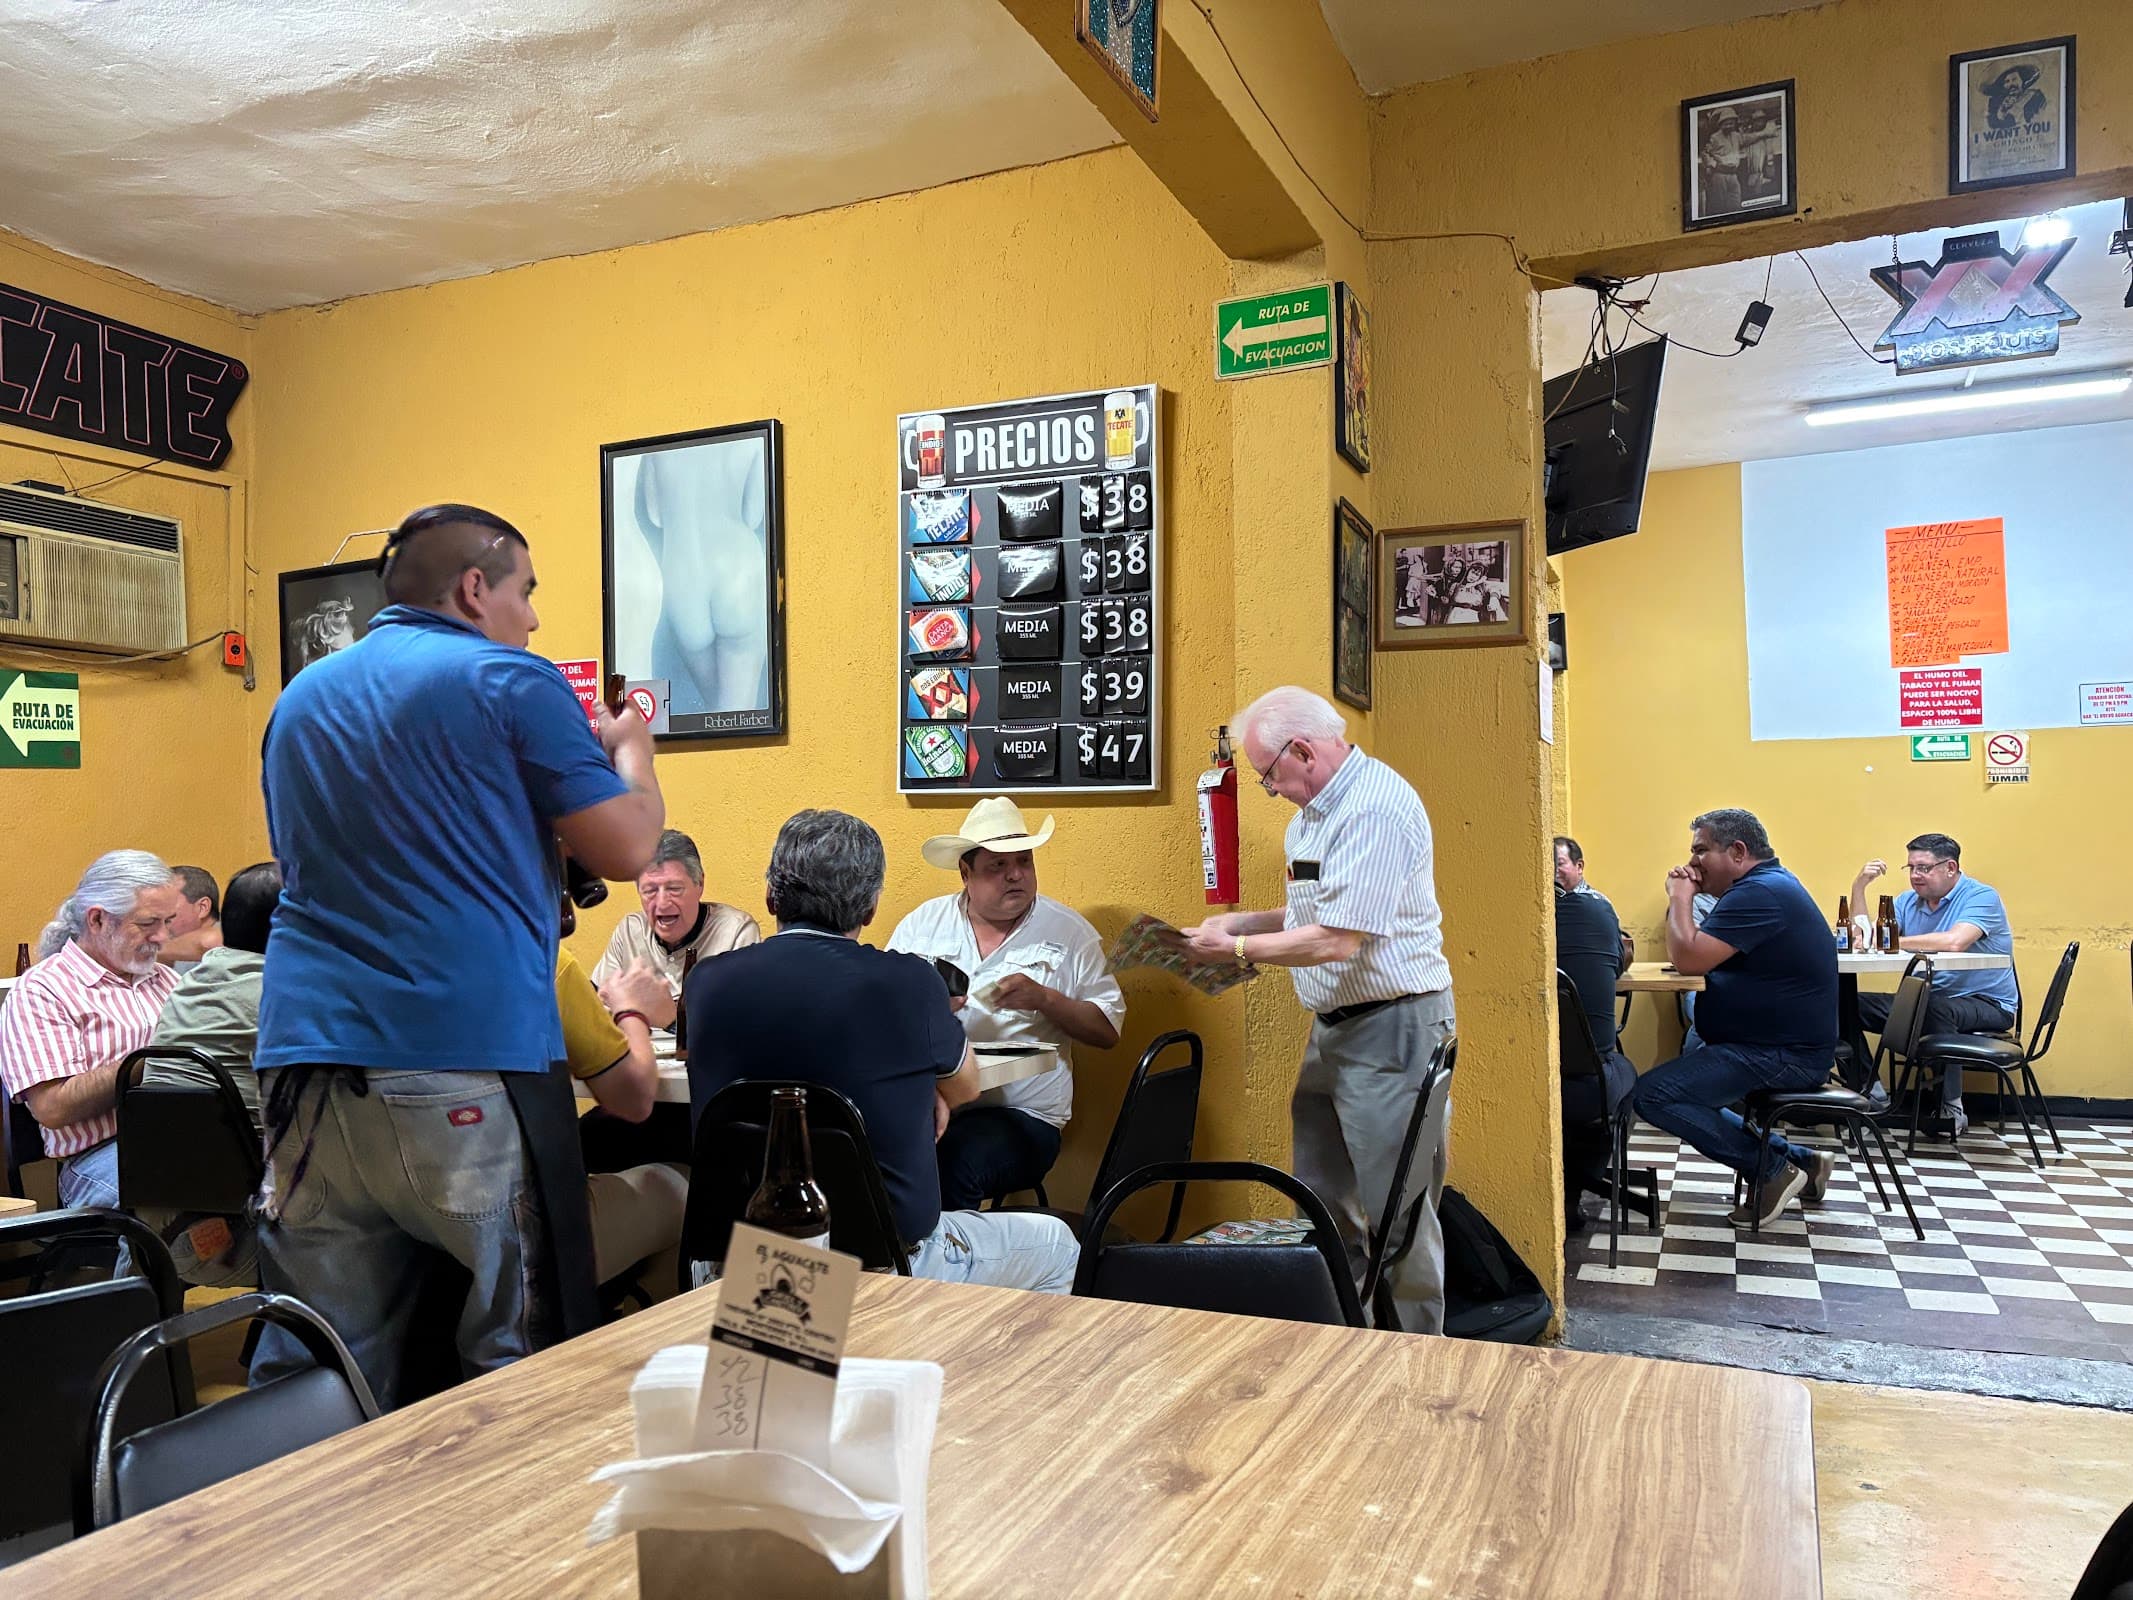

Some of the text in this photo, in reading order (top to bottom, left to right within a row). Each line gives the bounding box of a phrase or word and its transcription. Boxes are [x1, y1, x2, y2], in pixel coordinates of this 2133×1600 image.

[1973, 120, 2051, 144] I WANT YOU
[1258, 300, 1310, 320] RUTA DE
[1245, 340, 1326, 364] EVACUACION
[1107, 419, 1133, 431] TECATE
[955, 413, 1096, 474] PRECIOS
[1005, 498, 1050, 514] MEDIA
[1081, 484, 1147, 520] $38
[1912, 548, 1942, 563] BONE
[1007, 559, 1050, 574] MEA
[1081, 547, 1147, 583] $38
[1956, 567, 2000, 579] NATURAL
[934, 577, 964, 601] INDIO
[928, 620, 949, 638] CARTA
[1004, 620, 1050, 635] MEDIA
[1081, 608, 1147, 643] $38
[929, 624, 954, 646] BLANCA
[567, 665, 584, 675] DEL
[1925, 671, 1950, 679] HUMO
[1007, 680, 1052, 695] MEDIA
[1081, 668, 1145, 704] $39
[1902, 682, 1933, 690] TABACO
[1952, 679, 1981, 687] FUMAR
[1903, 689, 1979, 699] PUEDE SER NOCIVO
[12, 702, 74, 719] RUTA DE
[1909, 700, 1931, 708] PARA
[1932, 699, 1943, 707] LA
[704, 712, 770, 729] Robert Farber
[1901, 710, 1935, 718] ESPACIO
[1958, 708, 1982, 716] LIBRE
[12, 717, 74, 731] EVACUACIÓN
[1922, 718, 1961, 727] DE HUMO
[1002, 740, 1047, 754] MEDIA
[1078, 732, 1144, 765] $47
[772, 1250, 830, 1275] AGUACATE
